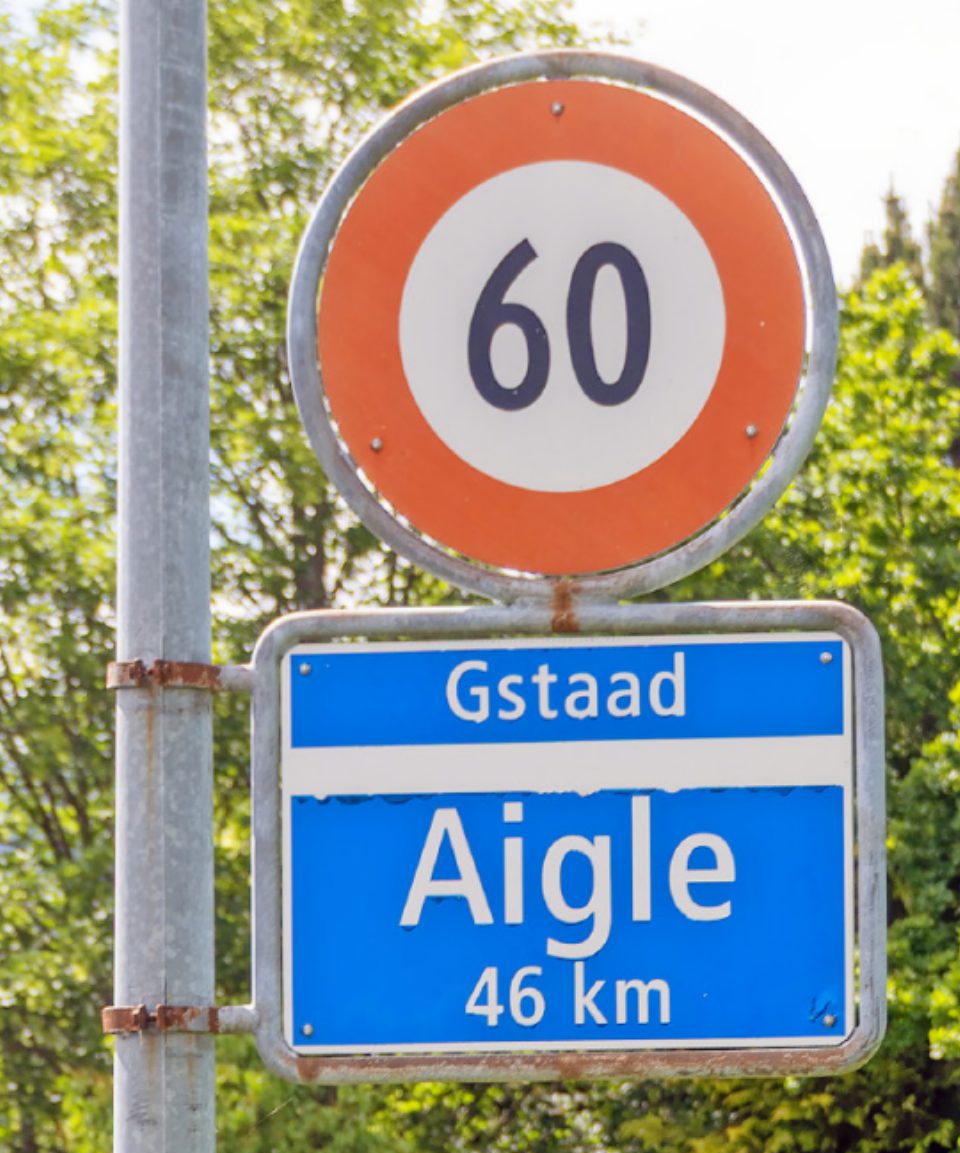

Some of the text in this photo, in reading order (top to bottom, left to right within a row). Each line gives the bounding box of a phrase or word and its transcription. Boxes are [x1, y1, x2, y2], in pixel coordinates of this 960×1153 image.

[468, 238, 651, 411] 60
[446, 651, 686, 723] Gstaad
[400, 795, 736, 959] Aigle
[465, 961, 671, 1027] 46 km
